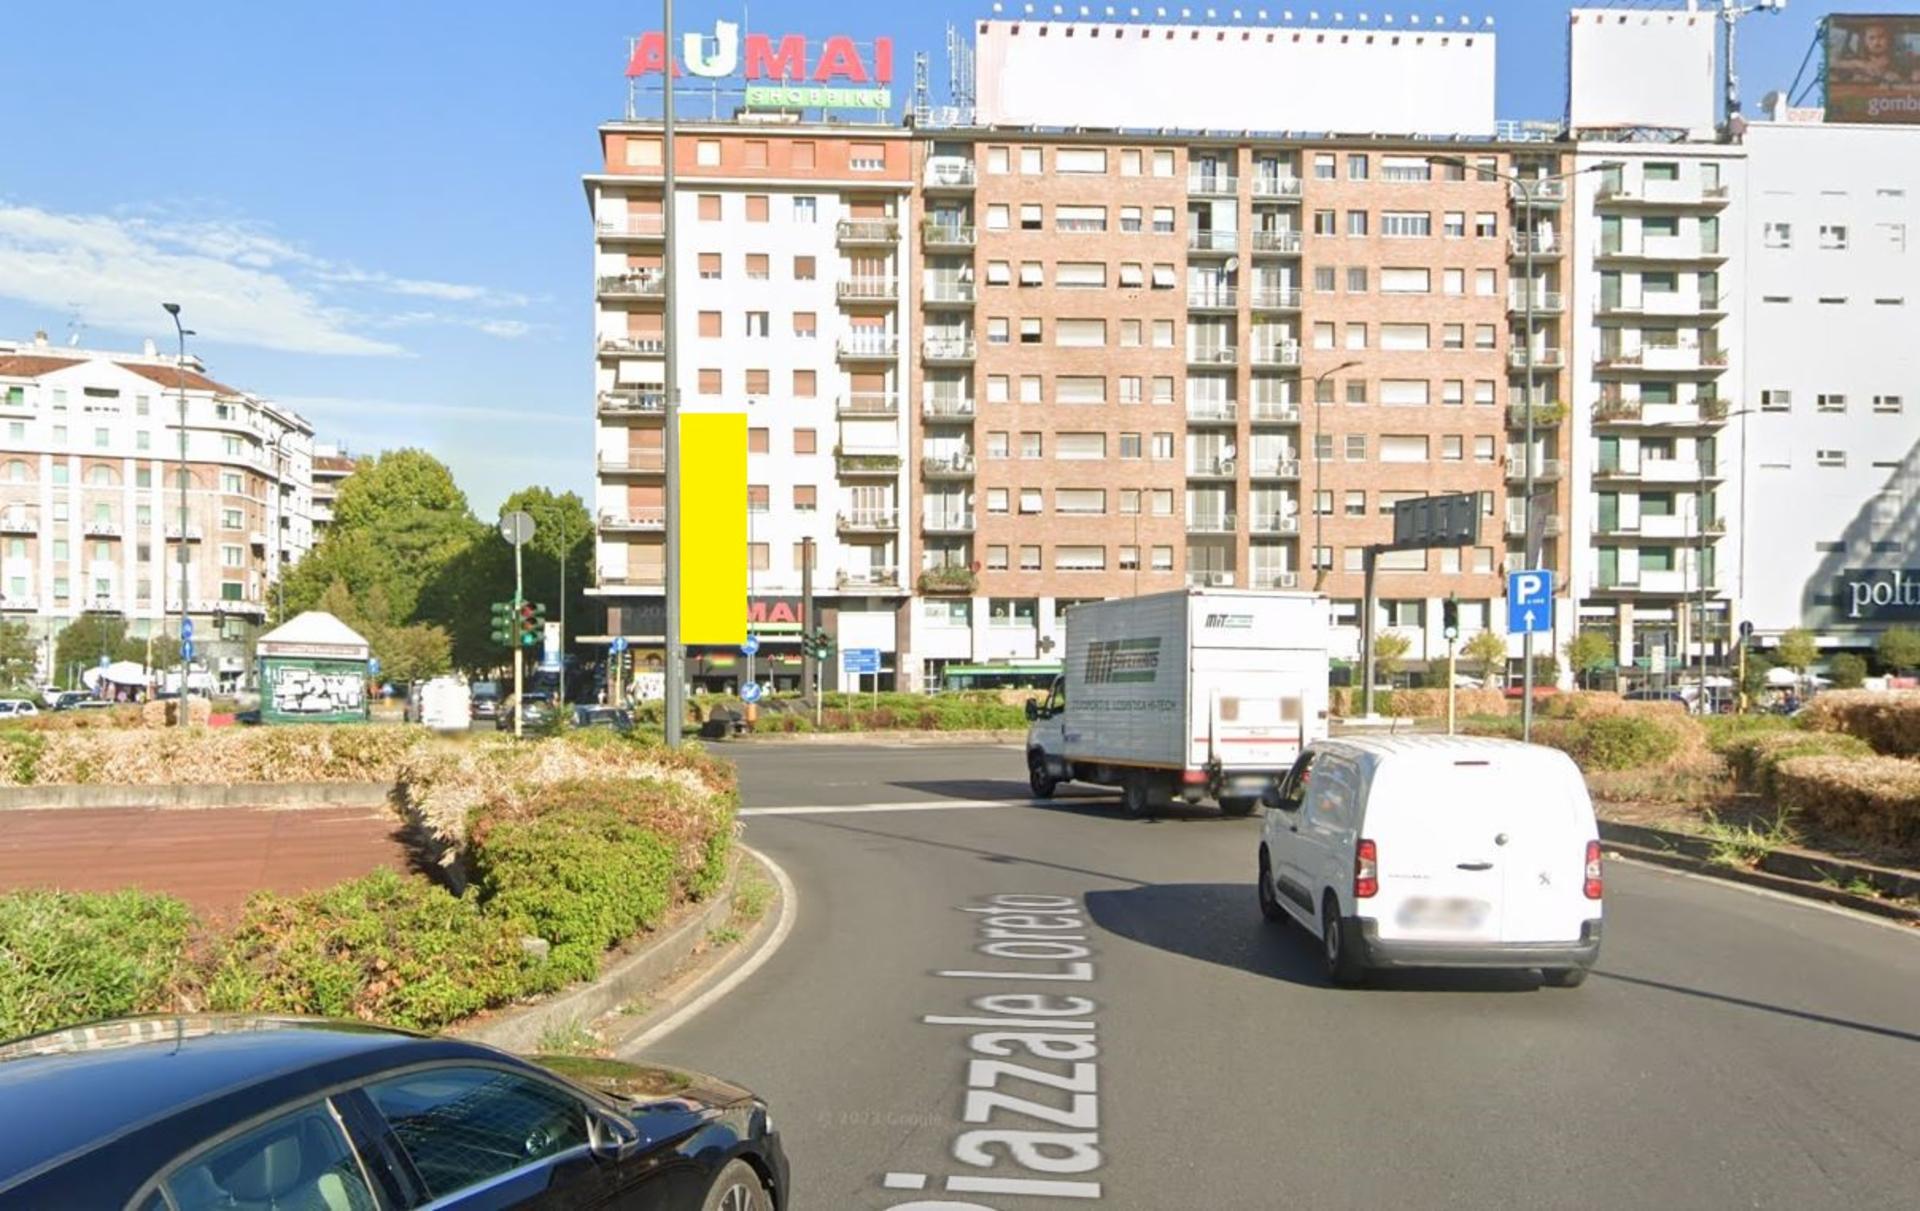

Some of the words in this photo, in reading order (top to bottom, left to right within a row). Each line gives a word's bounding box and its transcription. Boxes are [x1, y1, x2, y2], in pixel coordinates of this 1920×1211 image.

[624, 19, 893, 83] AUMAI
[751, 89, 885, 106] SHOPPING
[1867, 93, 1920, 116] gomb
[1517, 575, 1541, 605] P
[1847, 570, 1920, 617] polt
